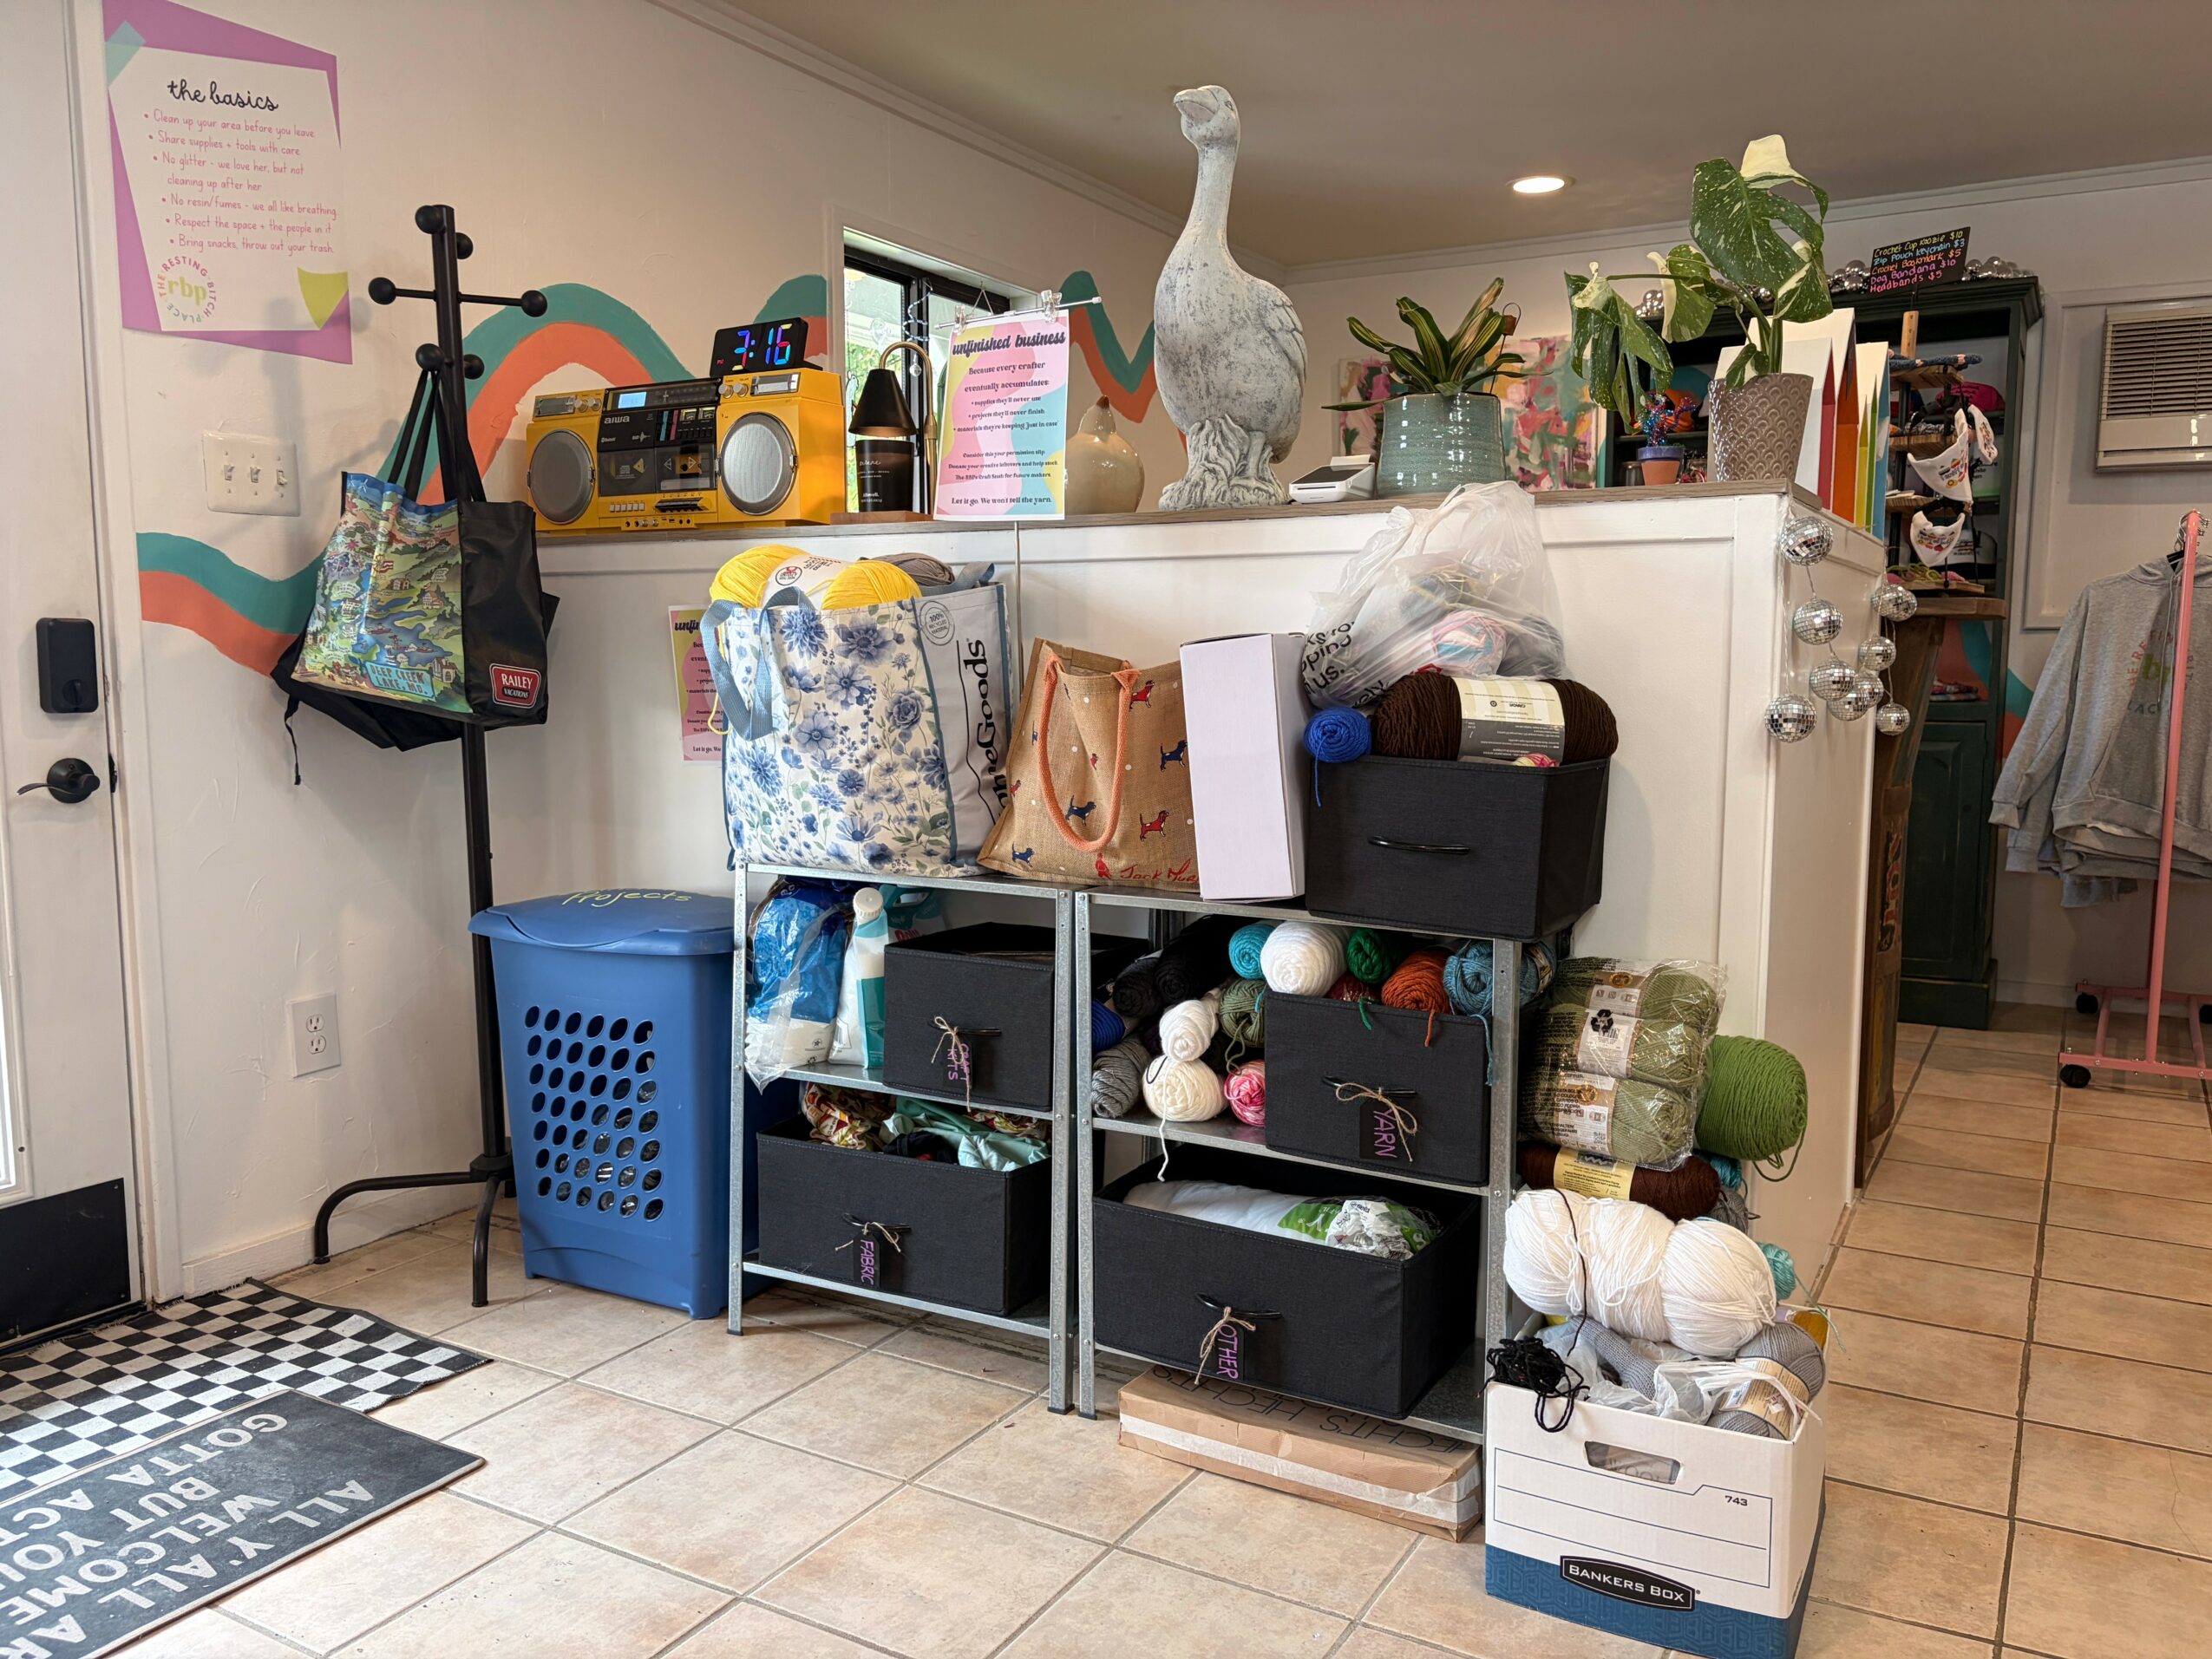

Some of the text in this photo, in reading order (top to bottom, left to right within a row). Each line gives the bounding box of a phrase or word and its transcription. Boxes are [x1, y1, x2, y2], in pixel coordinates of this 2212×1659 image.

[167, 79, 279, 111] the basics
[154, 108, 315, 140] Clean up your area before you leave
[158, 130, 301, 156] Share supplies tools with care
[162, 152, 304, 175] No glitter we love her, but not
[167, 176, 262, 193] cleaning up after her
[171, 193, 184, 206] No
[187, 196, 242, 210] resin/fumes
[268, 201, 278, 212] all
[280, 201, 294, 213] like
[298, 202, 337, 221] breathing
[174, 213, 331, 236] Respect the space the people in it
[179, 234, 334, 256] Bring snacks, throw out your trash
[1874, 246, 1902, 258] Crochet
[1904, 242, 1917, 251] Cup
[1950, 231, 1963, 240] $10
[1891, 251, 1914, 264] Pouch
[1953, 238, 1966, 248] $3
[161, 255, 208, 278] RESTING
[1870, 258, 1956, 285] Dog Bandana $10
[1871, 265, 1898, 275] Crochet
[1947, 248, 1962, 258] $5
[157, 273, 167, 297] THE
[167, 276, 207, 305] rbp
[1869, 271, 1942, 292] Headbands $5
[202, 281, 216, 317] BITCH
[167, 304, 202, 323] PLACE
[731, 323, 793, 370] 3:16
[952, 331, 1066, 358] unfinished business
[968, 361, 1046, 376] Because every crafter
[964, 382, 999, 392] eventually
[604, 415, 630, 424] aiwa
[370, 664, 425, 684] DEEP CREEK
[376, 676, 406, 692] LAKE,
[501, 673, 533, 689] RAILEY
[503, 688, 528, 698] VACATIONS
[1120, 863, 1162, 880] Jack
[561, 890, 692, 908] Projects
[947, 1048, 959, 1081] KITS
[1373, 1109, 1397, 1159] YARN
[860, 1239, 875, 1285] FABRIC
[1216, 1324, 1240, 1380] OTHER
[106, 1413, 289, 1486] GOTTA
[108, 1476, 222, 1532] BUT
[1725, 1494, 1748, 1507] 743
[0, 1492, 280, 1626] WELCOME
[0, 1479, 374, 1659] ALL Y'ALL AR
[1568, 1564, 1685, 1603] BANKERS BOX
